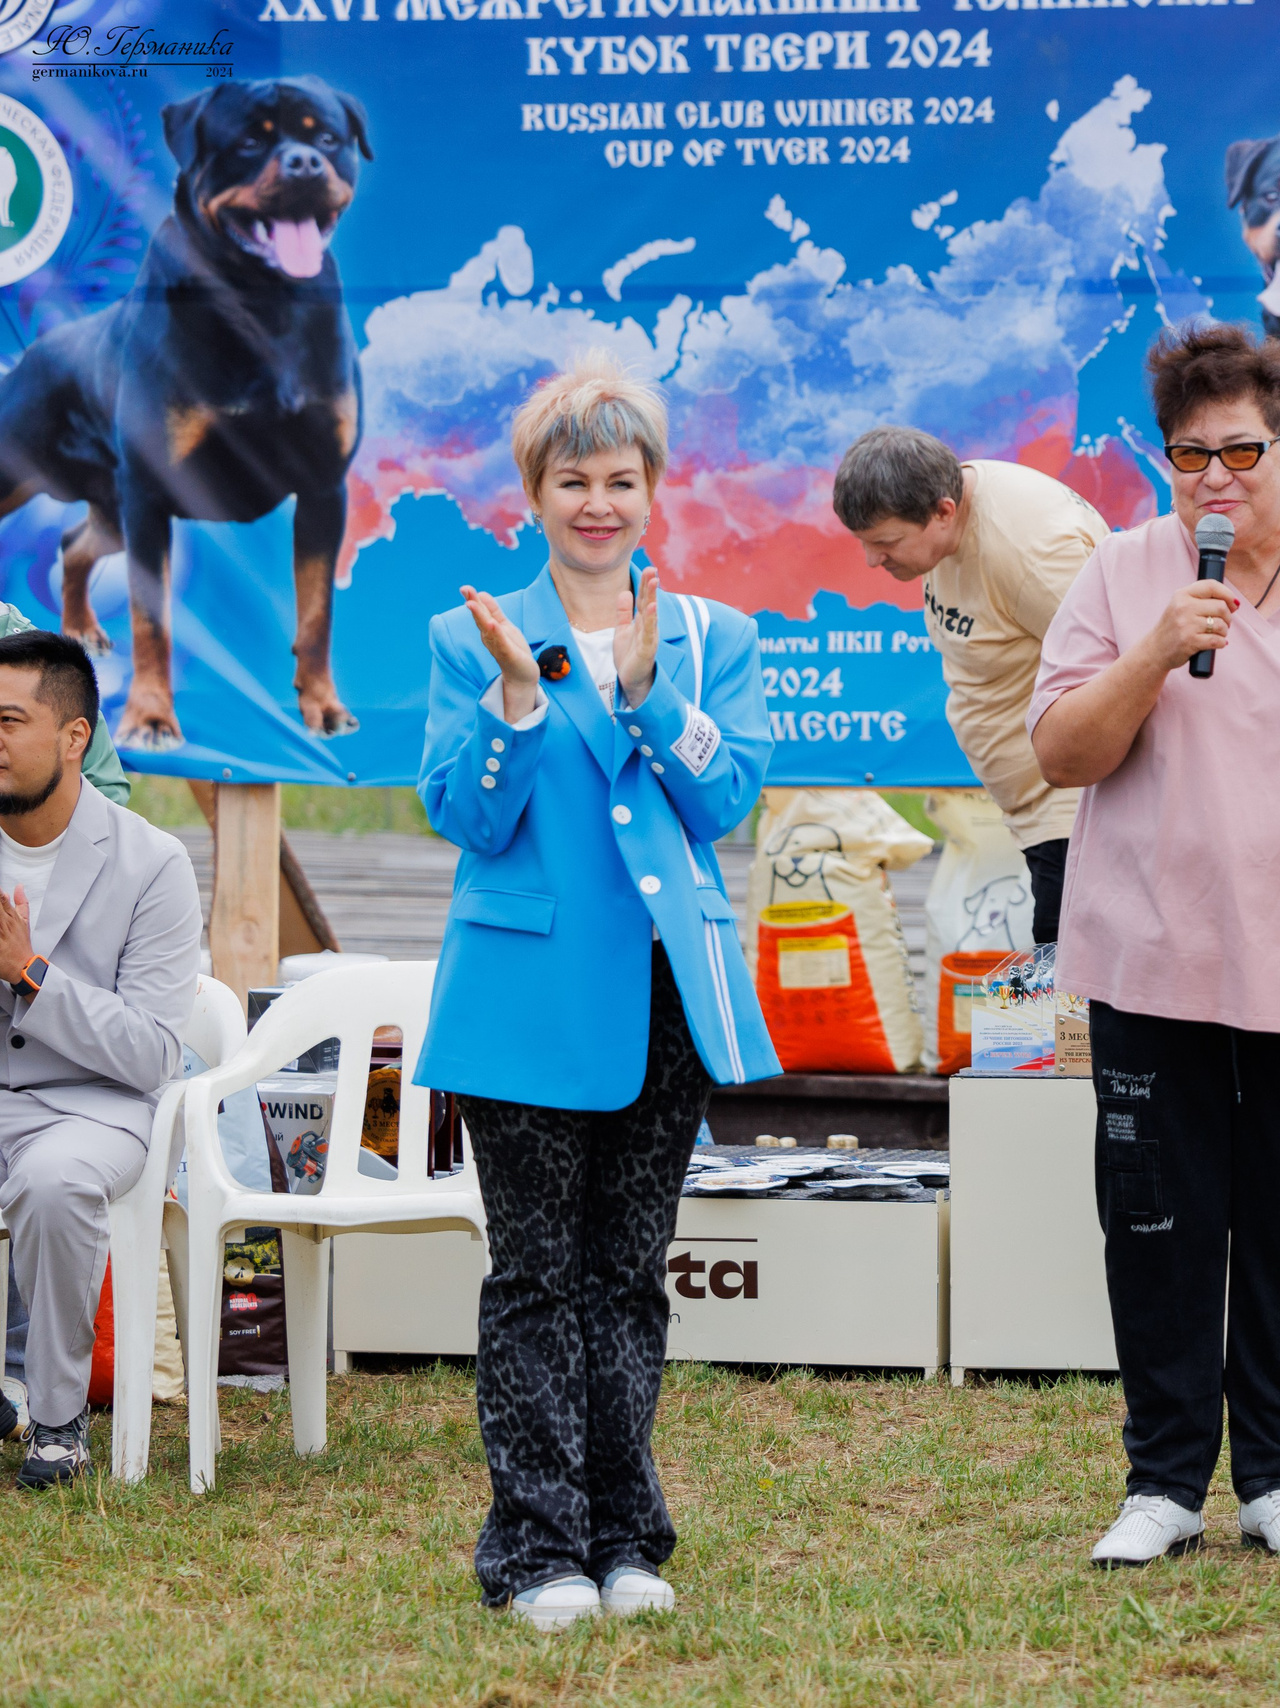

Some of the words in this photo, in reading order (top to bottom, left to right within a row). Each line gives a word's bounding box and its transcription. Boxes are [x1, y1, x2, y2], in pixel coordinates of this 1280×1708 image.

[526, 35, 690, 76] КУБОК
[705, 31, 870, 73] ТВЕРИ
[885, 28, 993, 69] 2024
[521, 102, 666, 133] RUSSIAN
[675, 101, 766, 129] CLUB
[774, 98, 914, 128] WINNER
[923, 97, 995, 125] 2024
[604, 140, 674, 169] CUP
[682, 139, 727, 168] OF
[735, 137, 830, 166] TVER
[839, 136, 911, 164] 2024
[891, 630, 940, 654] Рот
[762, 666, 844, 698] 2024
[1060, 1031, 1066, 1041] 3
[1068, 1032, 1090, 1041] МЕС
